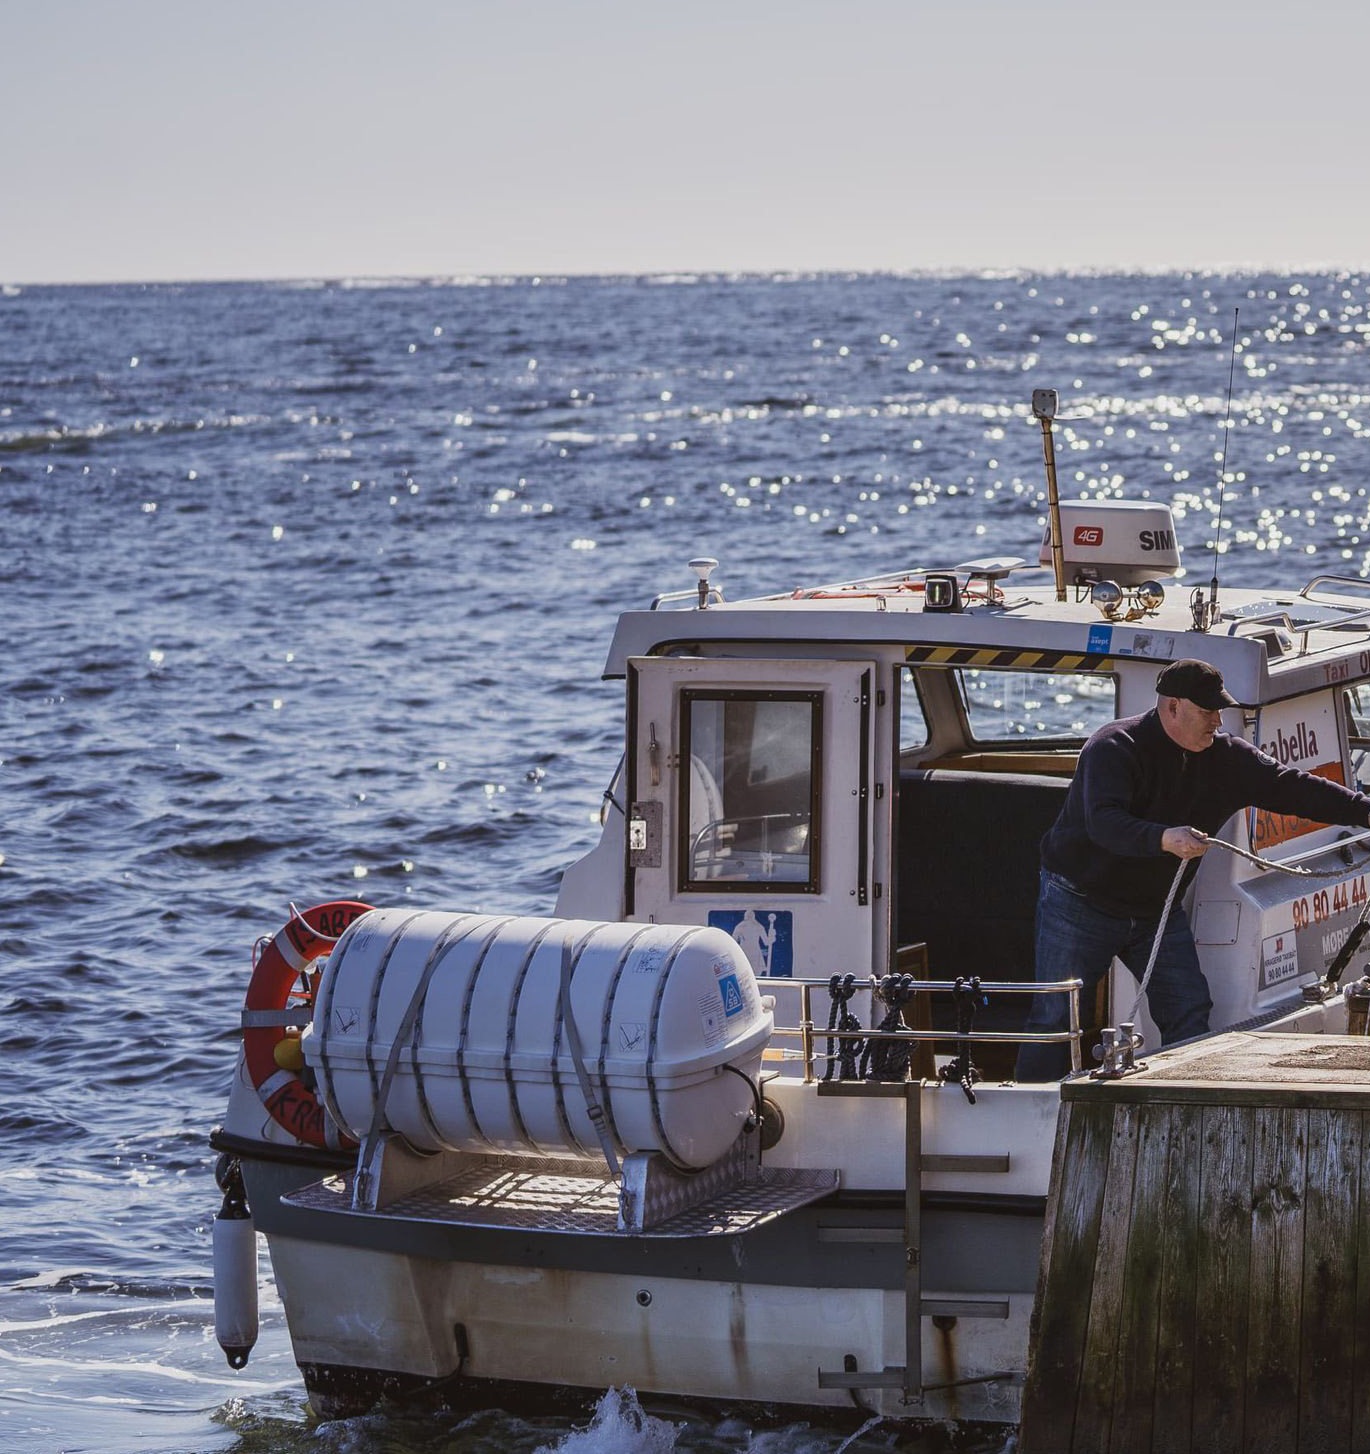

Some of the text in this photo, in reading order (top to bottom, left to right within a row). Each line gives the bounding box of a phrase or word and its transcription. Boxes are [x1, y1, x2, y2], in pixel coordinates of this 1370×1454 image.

[1077, 529, 1099, 542] 4G
[1323, 660, 1349, 683] Taxi
[1292, 875, 1367, 932] 90 80 44 44
